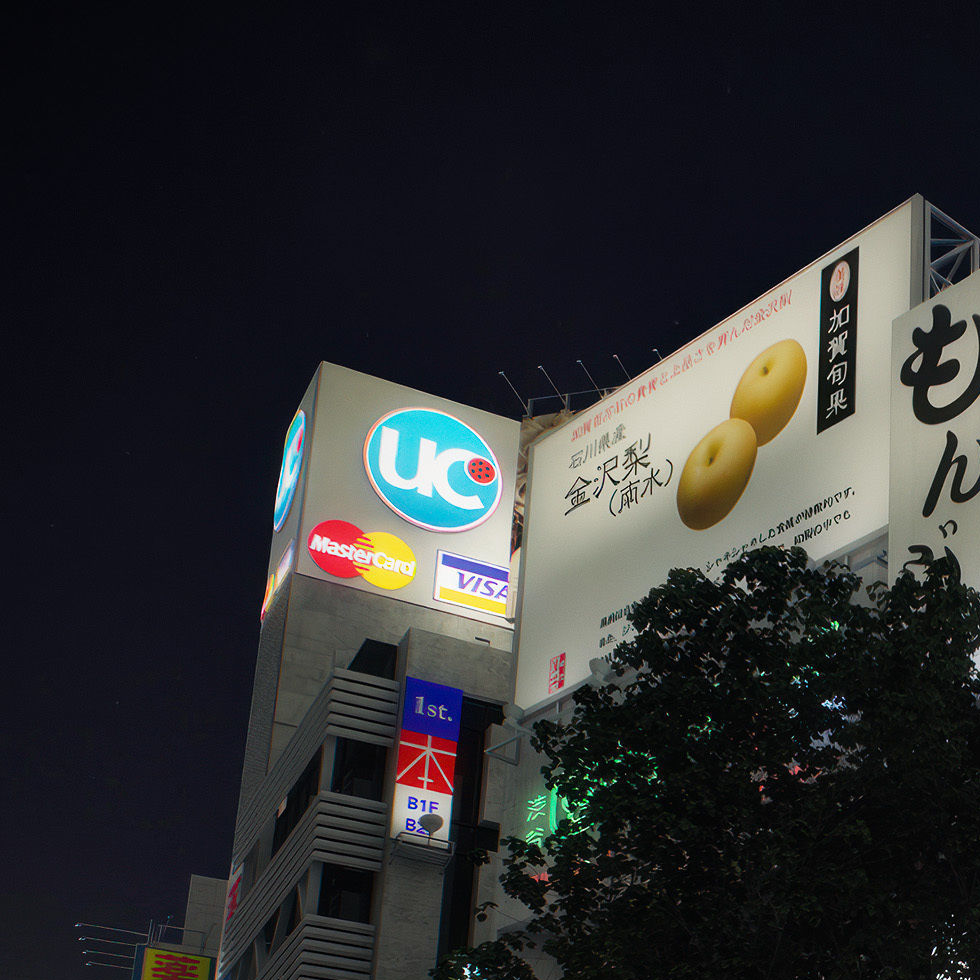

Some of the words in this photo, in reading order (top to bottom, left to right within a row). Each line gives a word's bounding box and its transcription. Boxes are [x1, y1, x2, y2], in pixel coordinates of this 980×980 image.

[826, 304, 850, 420] 加賀旬果
[565, 433, 651, 516] 金沢梨
[309, 533, 416, 577] MasterCard
[456, 571, 510, 600] VISA
[415, 696, 453, 722] 1st.
[407, 796, 440, 814] B1F
